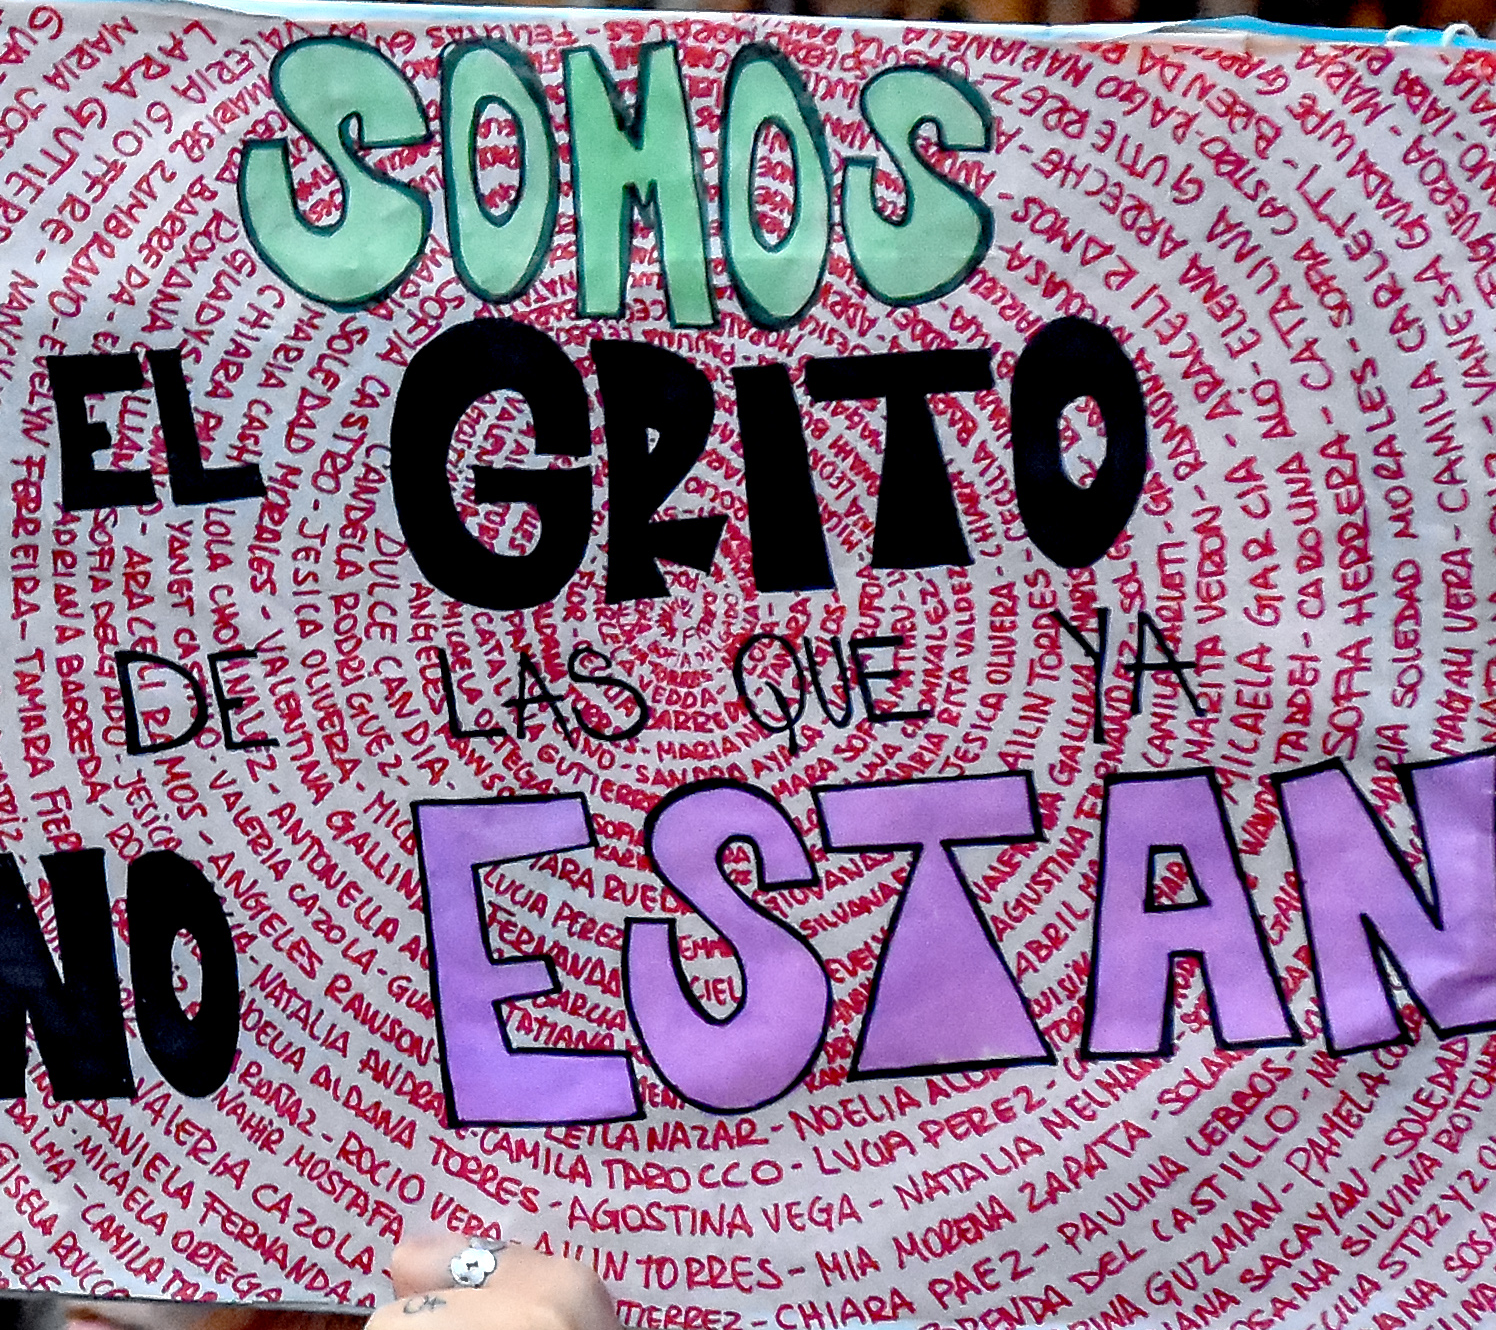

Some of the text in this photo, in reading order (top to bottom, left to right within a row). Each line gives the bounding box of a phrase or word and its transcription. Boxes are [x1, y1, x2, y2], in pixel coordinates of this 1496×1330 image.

[43, 18, 136, 91] MARIA
[103, 20, 216, 97] LARA
[1096, 76, 1199, 144] RAGO
[42, 102, 172, 243] GIOFFRE
[237, 35, 994, 330] SOMOS
[1033, 149, 1187, 259] ARRECHE
[1199, 137, 1297, 234] CASTRO
[142, 210, 237, 332] ROXANA
[180, 250, 256, 363] GLADYS
[1179, 254, 1261, 358] ELENA
[1207, 206, 1333, 390] CATALINA
[208, 285, 285, 398] CHIARA
[286, 317, 368, 453] SOLEDAD
[1137, 44, 1478, 632] VERA CAMILA CARLETTI BRENDA
[43, 345, 266, 513] EL
[389, 315, 1148, 611] GRITO
[312, 375, 390, 493] CASTRO
[1011, 197, 1284, 626] VERON GARCIA ARACELI RAMOS
[1351, 358, 1417, 538] MORALES
[168, 522, 194, 615] YANET
[248, 464, 301, 594] MORALES
[293, 519, 328, 638] JESICA
[1319, 434, 1375, 625] HERRERA
[53, 512, 111, 803] ADRIANA BARREDA
[114, 647, 280, 756] DE
[437, 644, 651, 744] LAS
[732, 633, 933, 756] QUE
[1051, 606, 1207, 744] YA
[331, 594, 402, 776] RODRIGUEZ
[359, 529, 449, 785] DULCE CANDIA
[940, 582, 1018, 775] JESICA OLIVERA
[1392, 559, 1422, 706] SOLEDAD
[15, 648, 54, 777] TAMARA
[301, 650, 360, 783] OLIVERA
[998, 692, 1055, 770] AILIN
[1274, 655, 1320, 763] TADDEI
[210, 771, 377, 974] VALERIA CAZOLA
[991, 826, 1092, 941] AGUSTINA
[209, 853, 434, 1065] ANGELES RAWSON
[251, 965, 349, 1057] NATALIA
[216, 1087, 284, 1154] NAHIR
[337, 1131, 425, 1203] ROCIO
[480, 1127, 591, 1187] CAMILA
[603, 1158, 783, 1194] TAROCCO
[918, 1086, 1046, 1148] PEREZ
[647, 1086, 921, 1150] NAZAR NOELIA
[77, 1137, 167, 1235] MICAELA
[253, 1185, 375, 1274] CAZOLA
[569, 1196, 753, 1238] AGOSTINA
[763, 1195, 861, 1232] VEGA
[896, 1136, 1043, 1210] NATALIA
[636, 1121, 1150, 1292] TORRES MIA MORENA ZAPATA
[1069, 1241, 1145, 1294] DEL
[1152, 1105, 1299, 1241] CASTILLO
[1146, 1073, 1389, 1306] GUZMAN PAMELA
[1239, 1168, 1369, 1292] SACAYAN
[1342, 1153, 1442, 1256] SILVINA
[776, 1288, 916, 1330] CHIARA
[929, 1250, 1033, 1309] PAEZ
